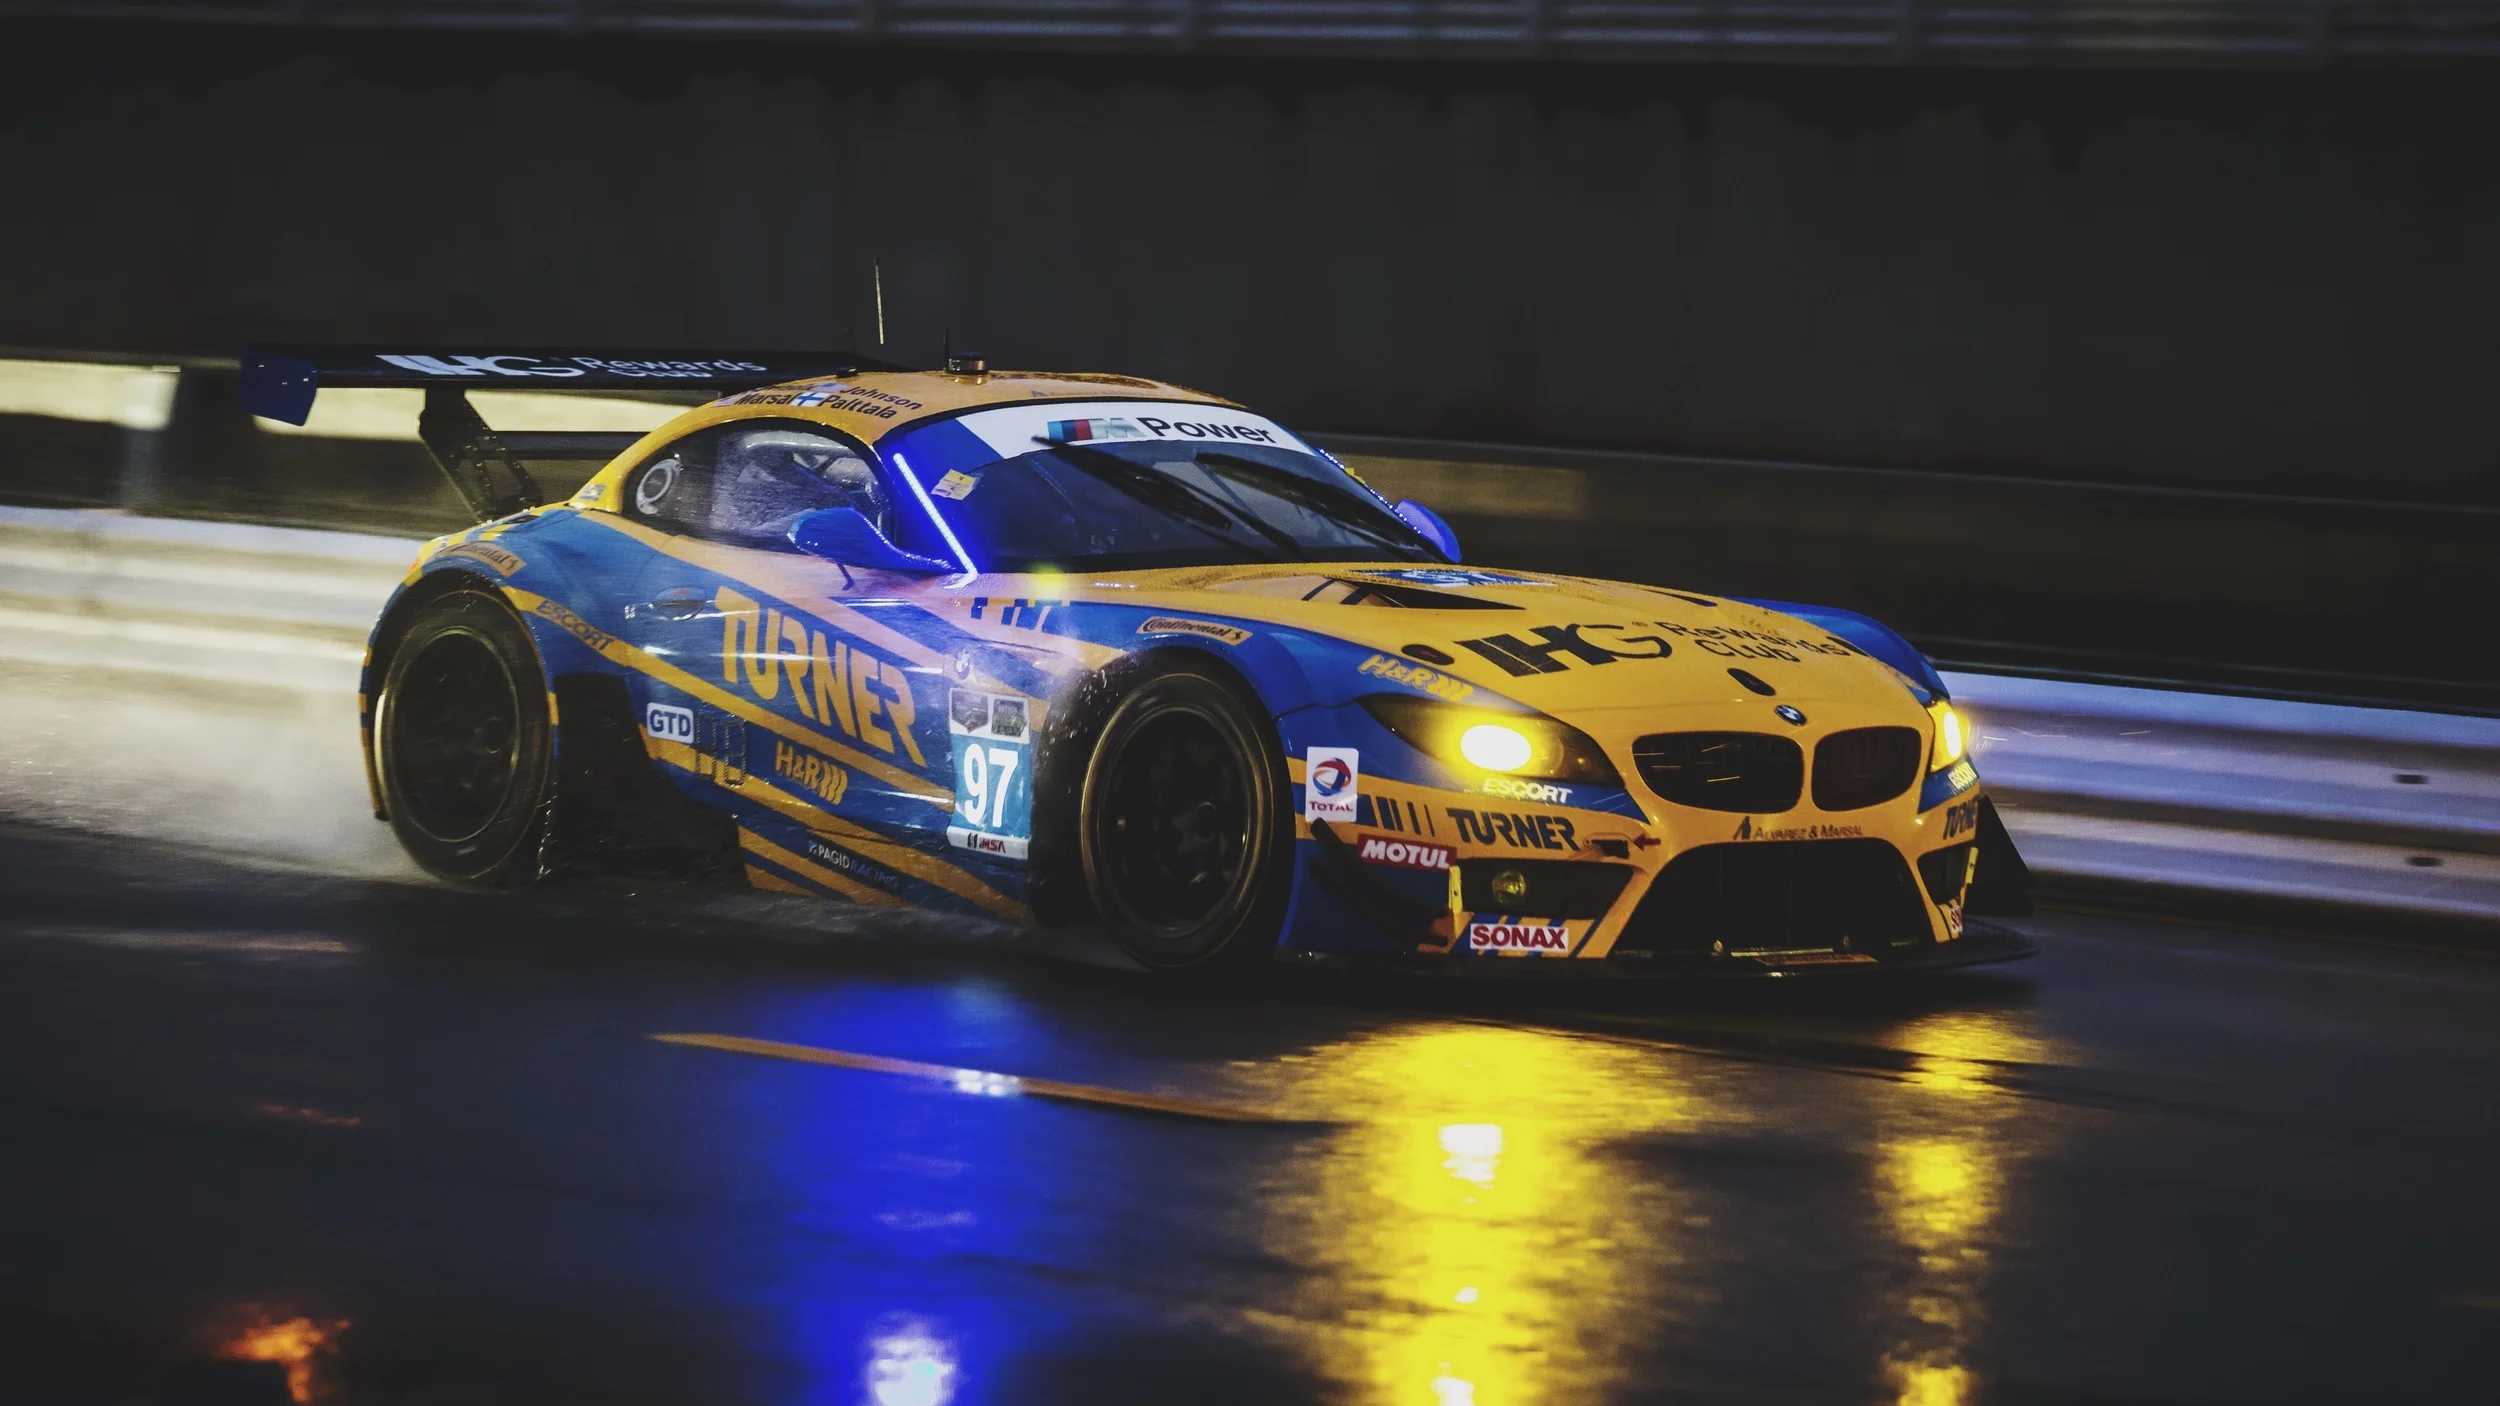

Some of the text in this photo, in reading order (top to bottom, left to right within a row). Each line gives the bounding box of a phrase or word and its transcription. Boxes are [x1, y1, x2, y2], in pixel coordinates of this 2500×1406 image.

[376, 354, 768, 378] IHG Rewards
[734, 392, 898, 419] Marsal Palttala
[839, 386, 923, 410] Johnson
[1136, 417, 1277, 444] Power
[536, 599, 616, 651] ESCORT
[1143, 617, 1233, 637] Continental
[1454, 621, 1851, 679] IHG Rewards
[1694, 638, 1801, 662] Club
[714, 584, 928, 768] TURNER
[649, 709, 692, 738] GTD
[962, 743, 1018, 829] 97
[1482, 777, 1573, 804] ESCORT
[1309, 800, 1354, 813] TOTAL
[1446, 807, 1581, 851] TURNER
[1361, 839, 1451, 868] MOTUL
[1472, 924, 1566, 949] SONAX
